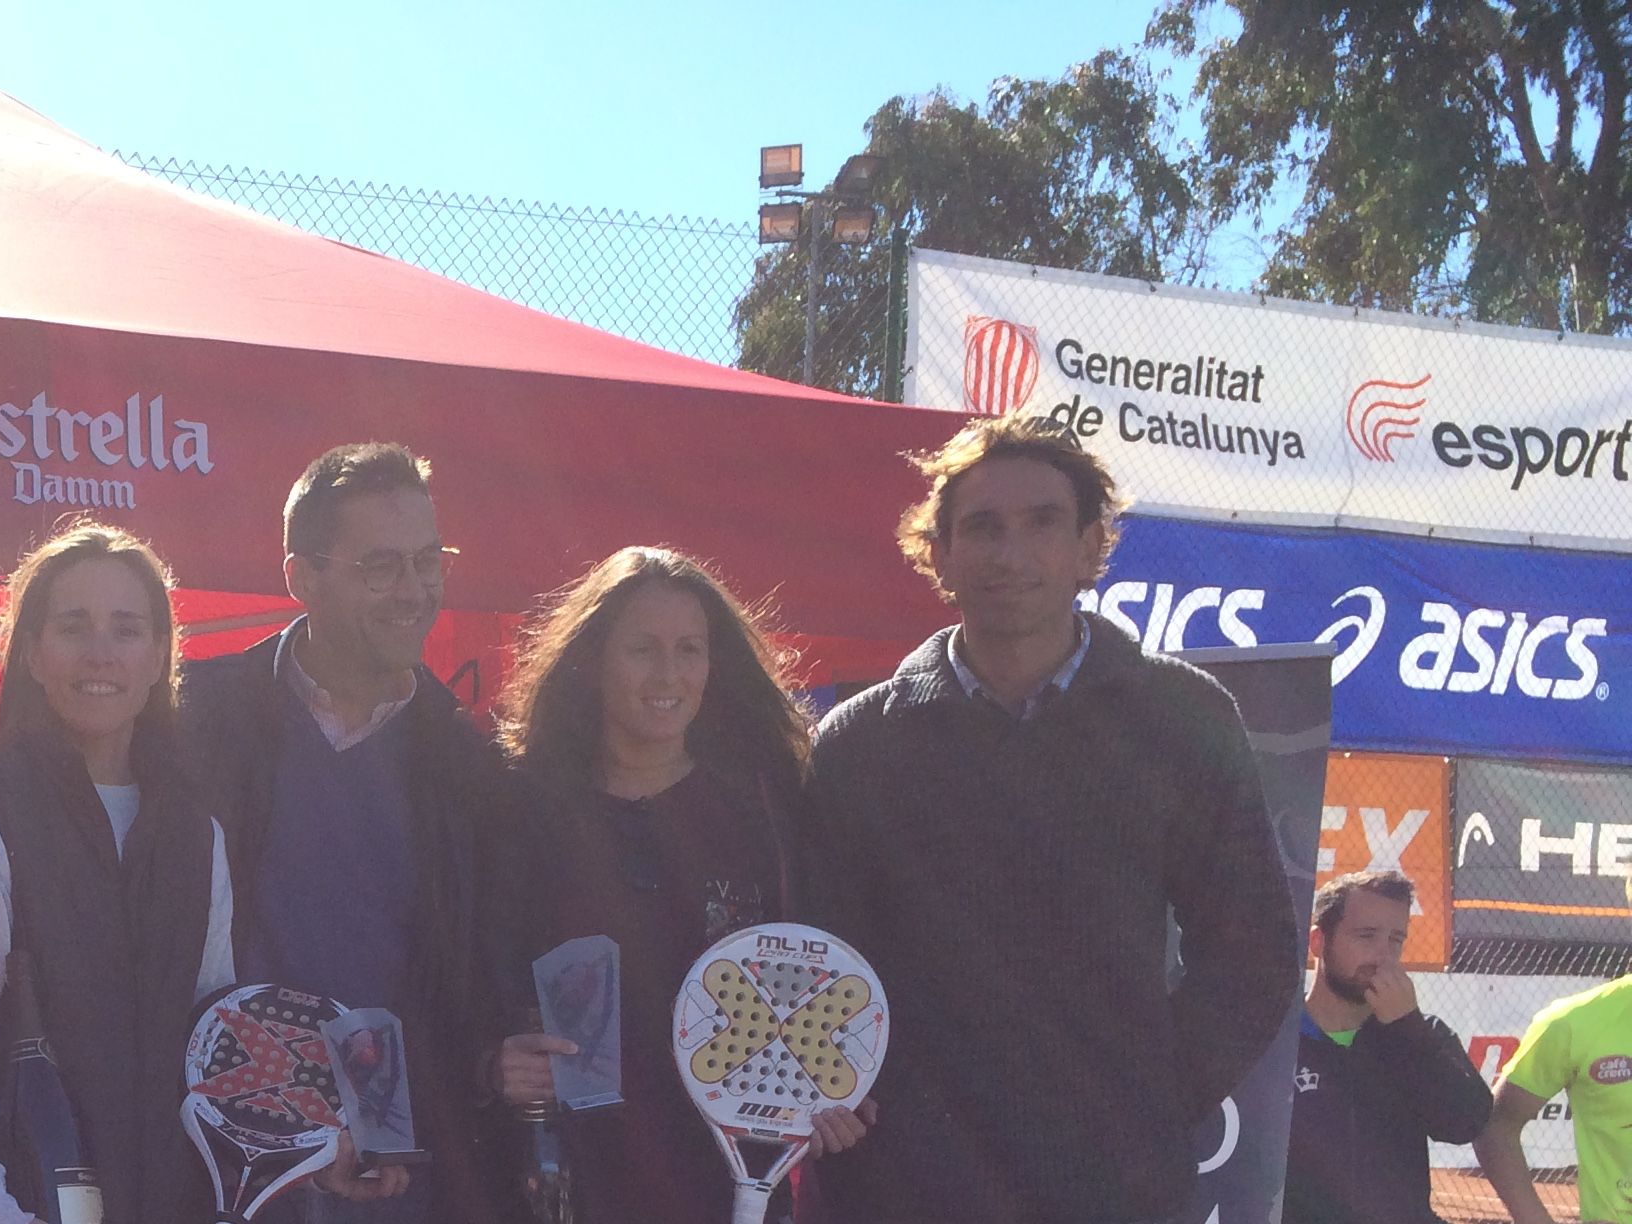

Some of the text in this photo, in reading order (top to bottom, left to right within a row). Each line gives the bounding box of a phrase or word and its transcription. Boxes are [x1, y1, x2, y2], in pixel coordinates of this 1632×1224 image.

[1054, 337, 1265, 404] Generalitat
[1050, 395, 1306, 467] de Catalunya
[1431, 419, 1632, 491] esport
[10, 459, 136, 511] Damm
